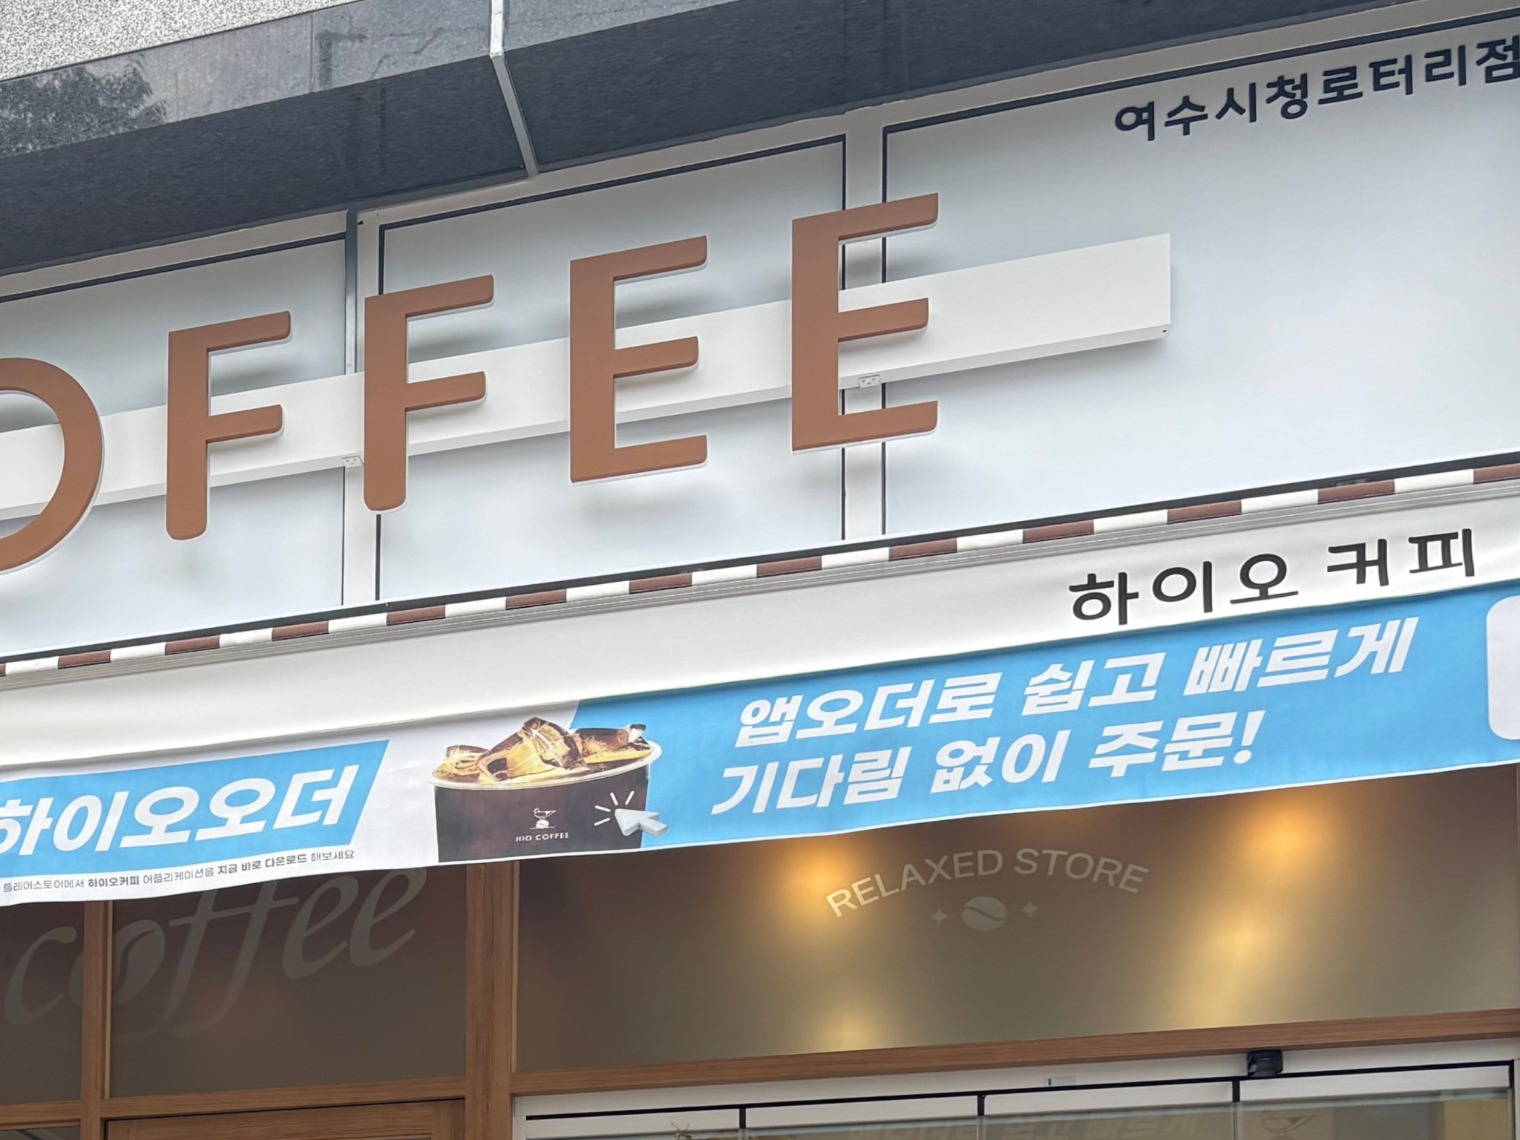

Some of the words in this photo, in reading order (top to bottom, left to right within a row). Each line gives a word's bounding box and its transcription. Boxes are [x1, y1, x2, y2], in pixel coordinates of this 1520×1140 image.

[1115, 35, 1520, 142] 여수시청로터리점
[1068, 553, 1299, 626] 하이오
[1326, 528, 1476, 587] 커피
[734, 672, 1003, 748] 앱오더로
[1021, 652, 1166, 716] 쉽고
[1183, 616, 1420, 696] 빠르게
[710, 745, 913, 816] 기다림
[930, 729, 1071, 794] 없이
[1088, 709, 1266, 779] 주문!
[88, 875, 140, 888] 하이오커피
[217, 863, 239, 875] 지금
[241, 860, 261, 871] 바로
[515, 834, 533, 843] HIO
[535, 831, 570, 842] COFFEE
[825, 849, 1004, 918] RELAXED
[1014, 848, 1150, 894] STORE
